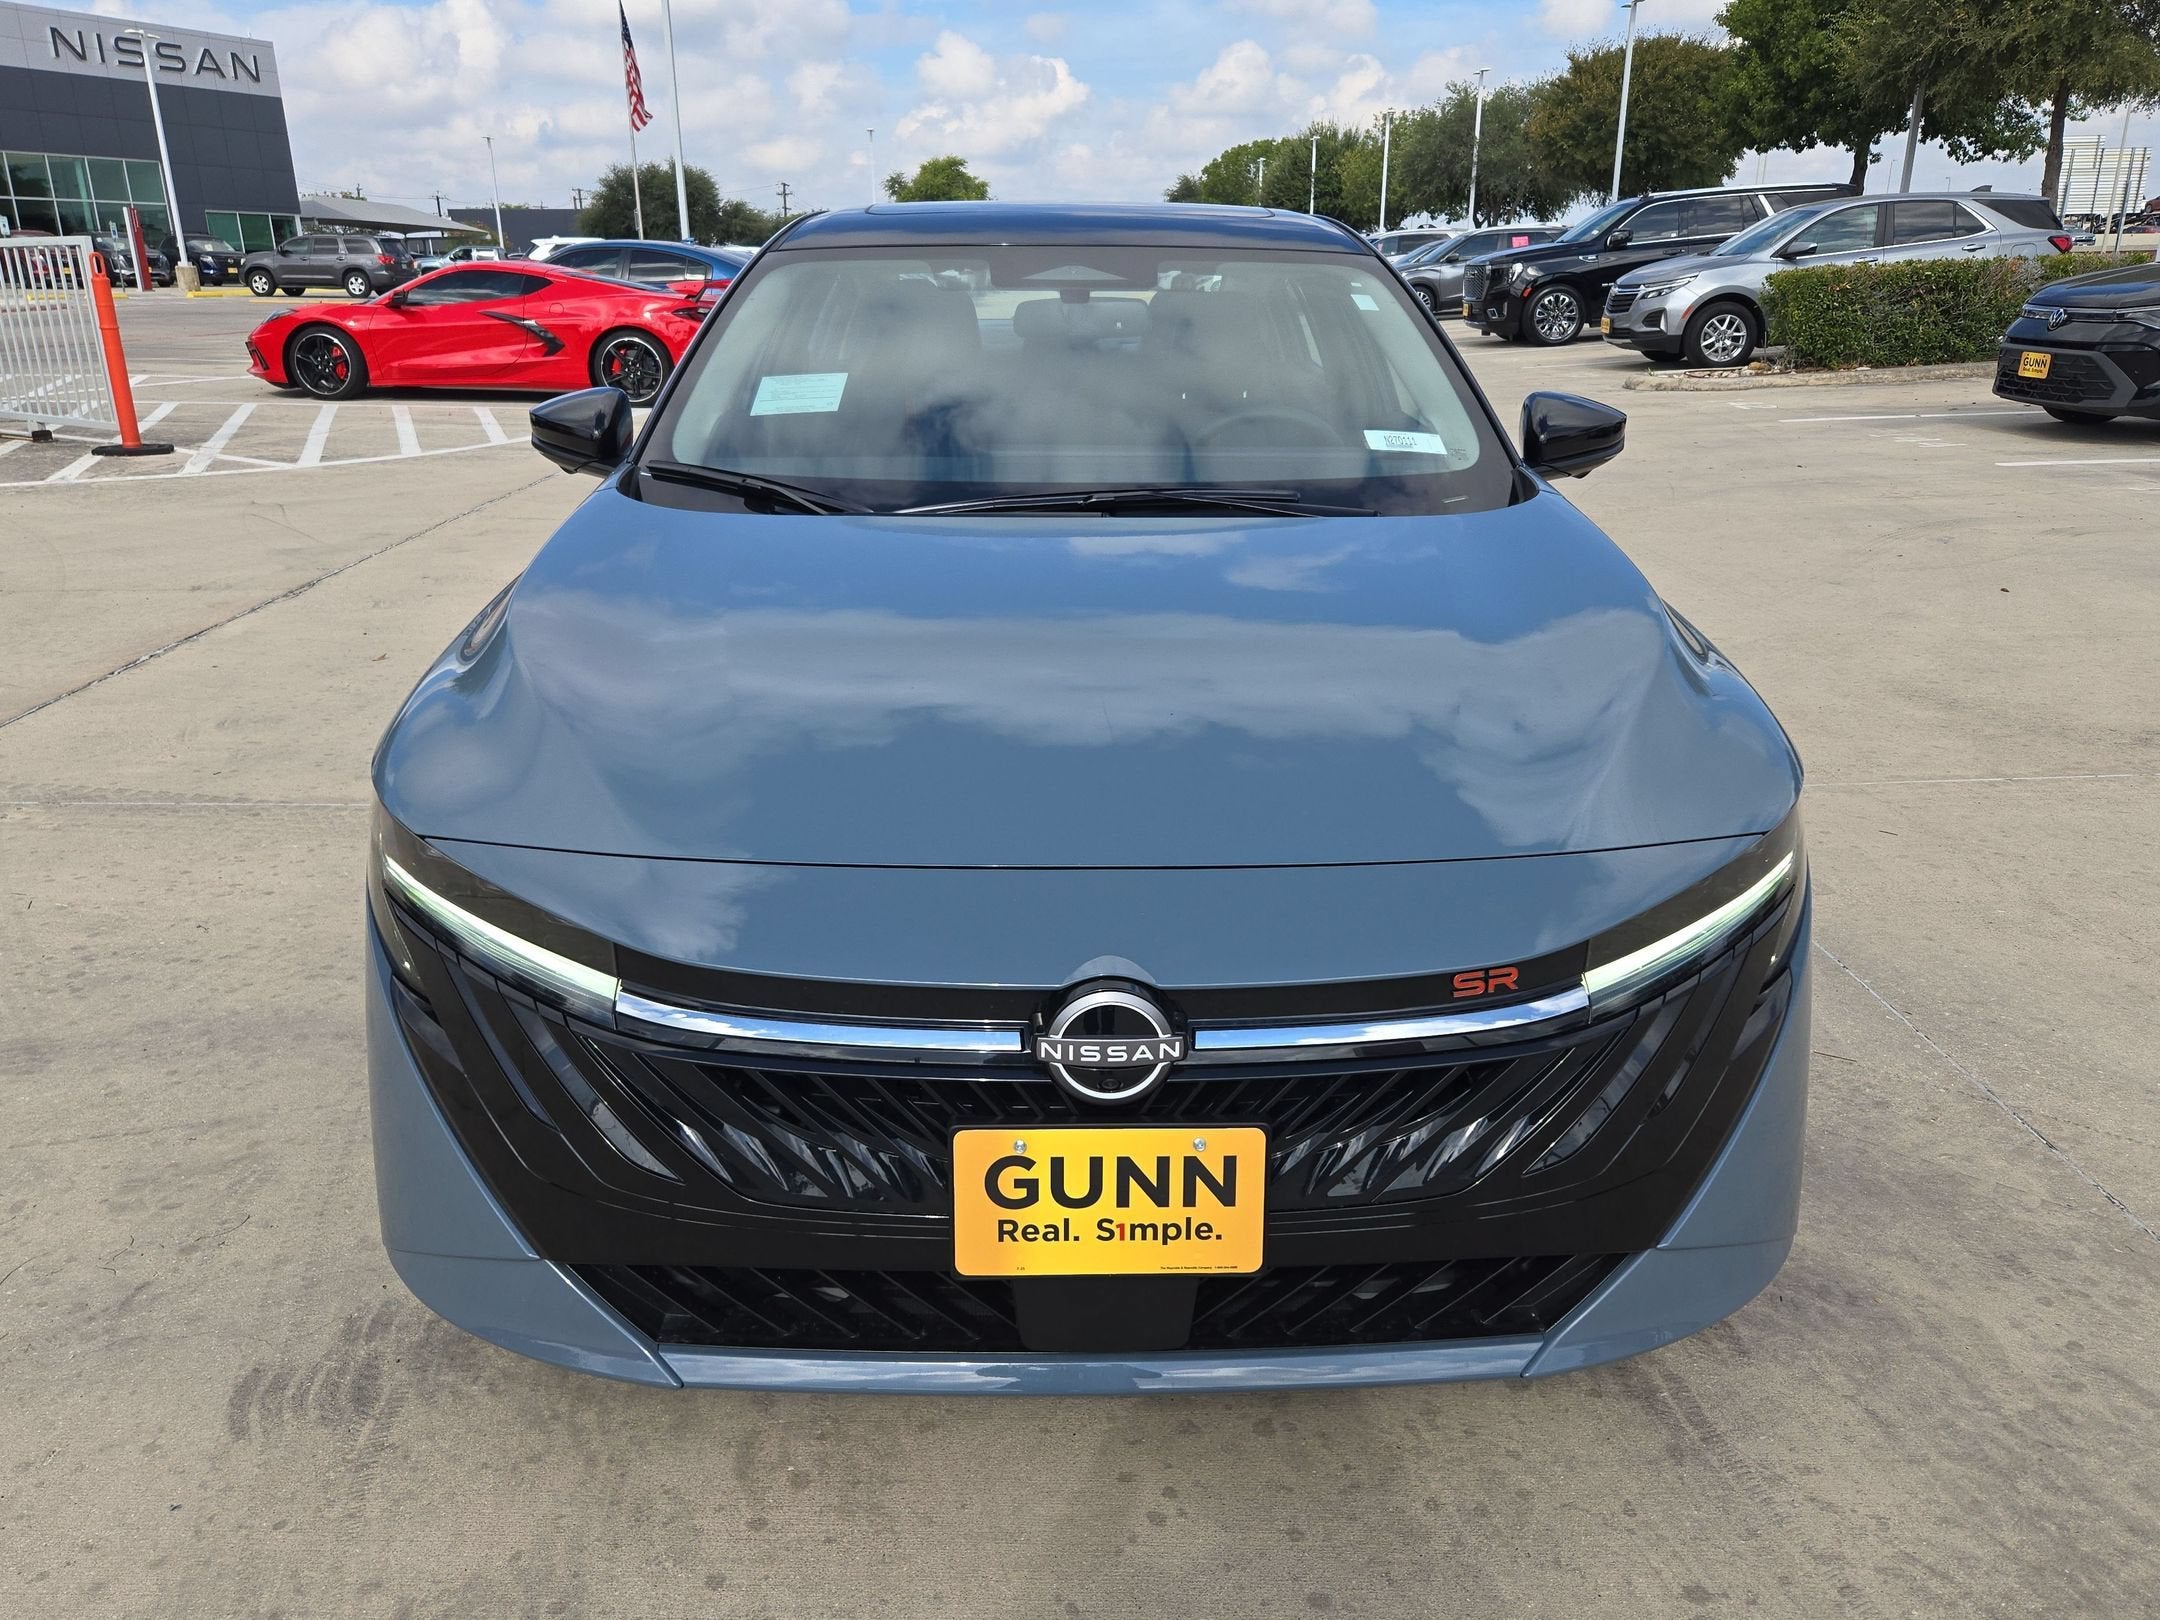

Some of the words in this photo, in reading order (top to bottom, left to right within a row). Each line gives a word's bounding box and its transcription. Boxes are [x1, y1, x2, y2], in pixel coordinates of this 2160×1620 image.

[50, 26, 261, 83] NISSAN
[2023, 357, 2047, 369] GUNN
[1453, 966, 1519, 998] SR
[1040, 1041, 1180, 1063] NISSAN
[984, 1155, 1237, 1210] GUNN
[997, 1218, 1080, 1243] Real.
